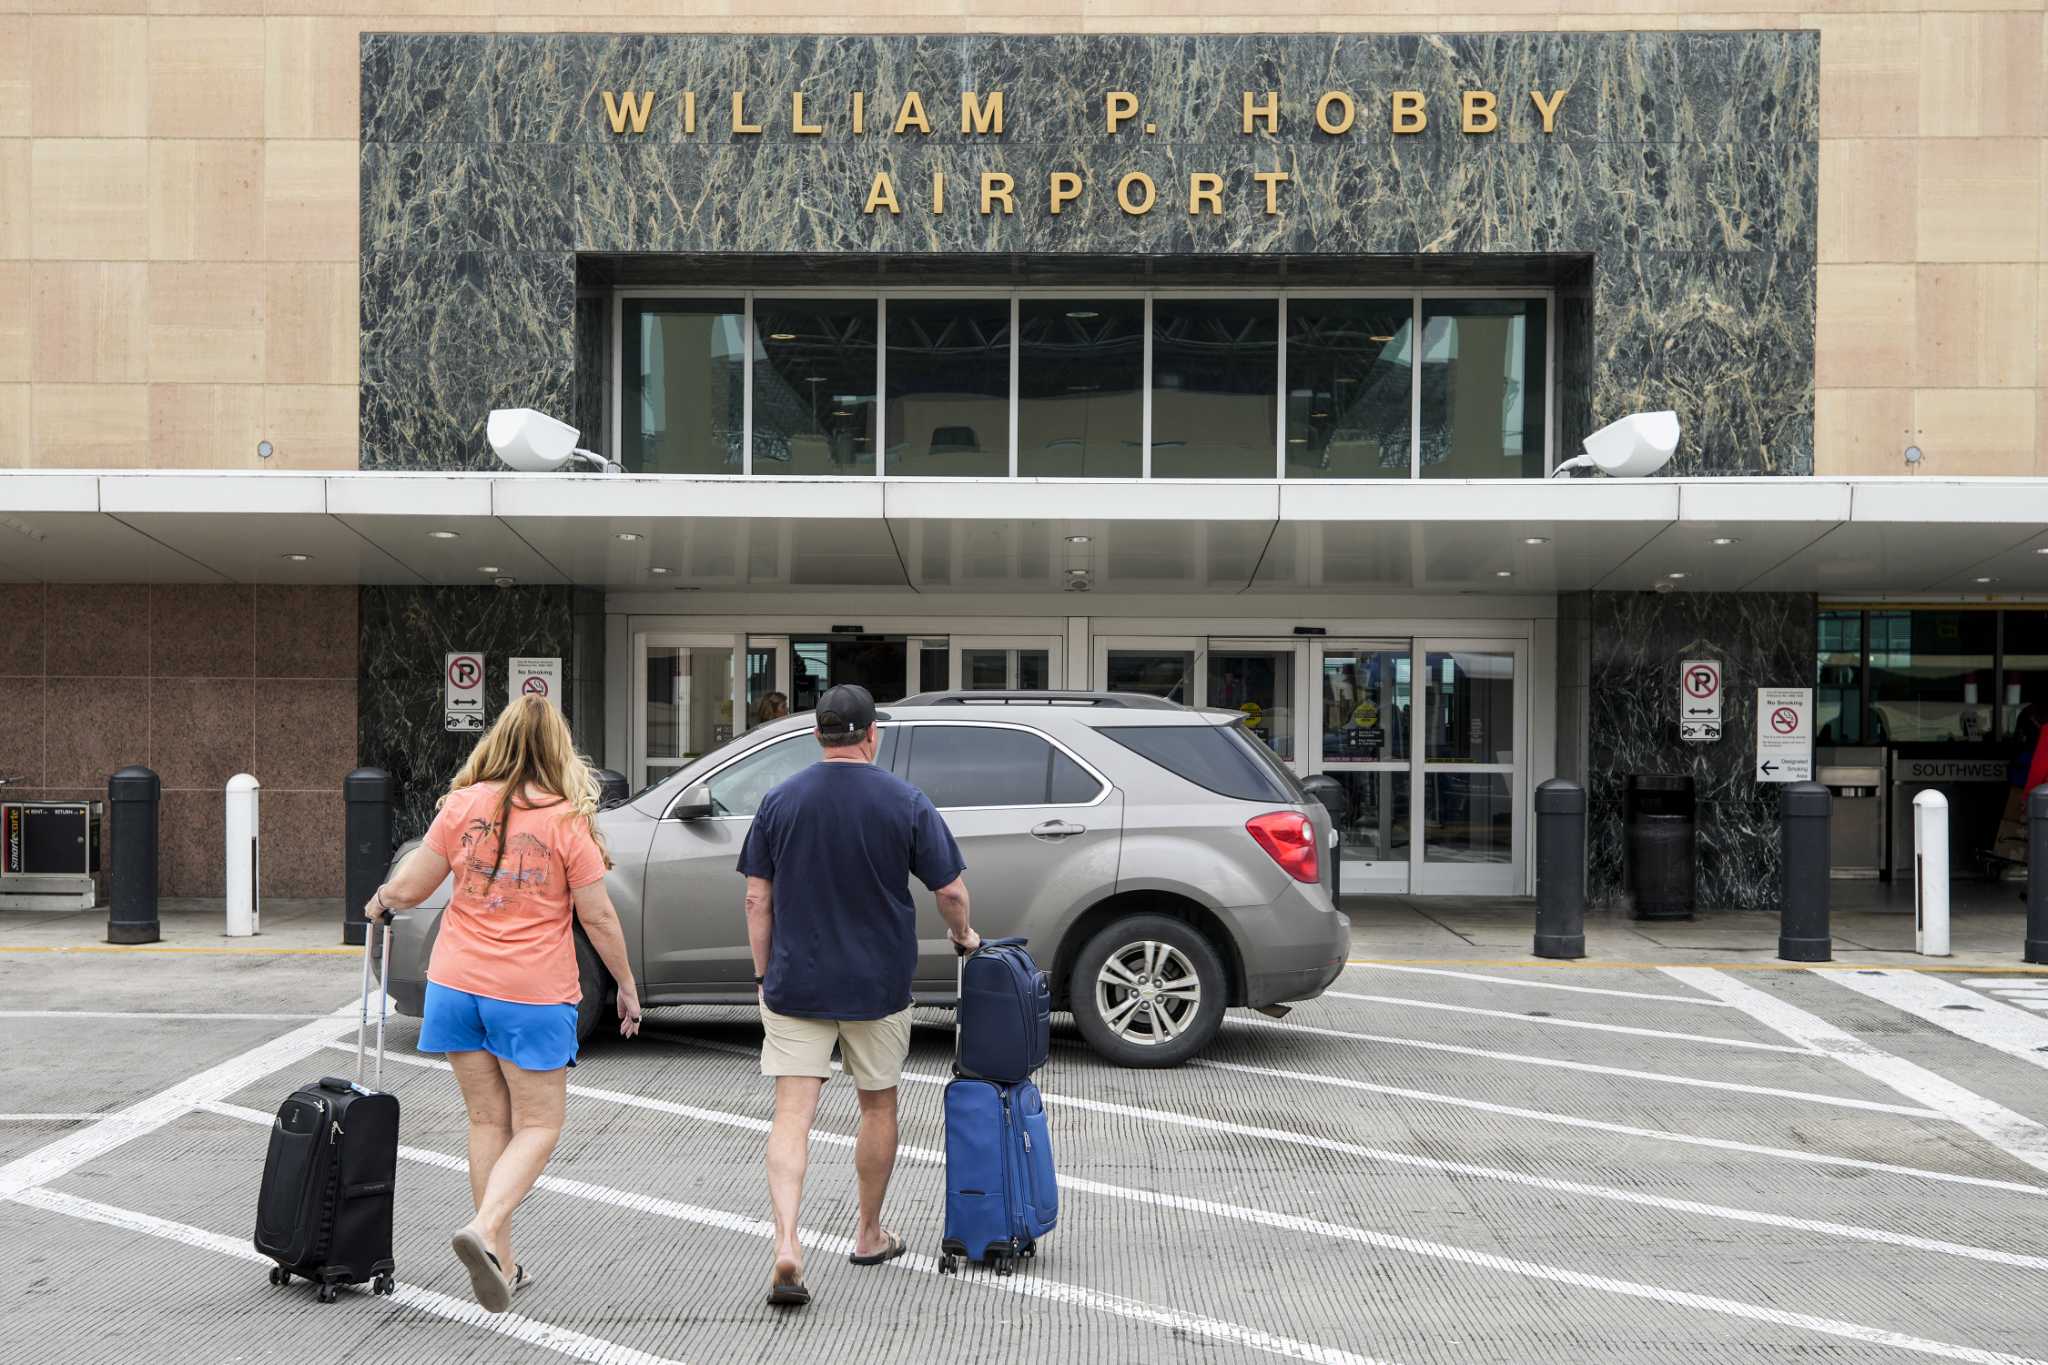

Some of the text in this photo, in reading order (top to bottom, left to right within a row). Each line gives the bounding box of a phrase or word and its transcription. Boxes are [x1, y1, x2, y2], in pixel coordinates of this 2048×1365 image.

[602, 89, 1567, 135] WILLIAM P. HOBBY
[864, 170, 1289, 216] AIRPORT
